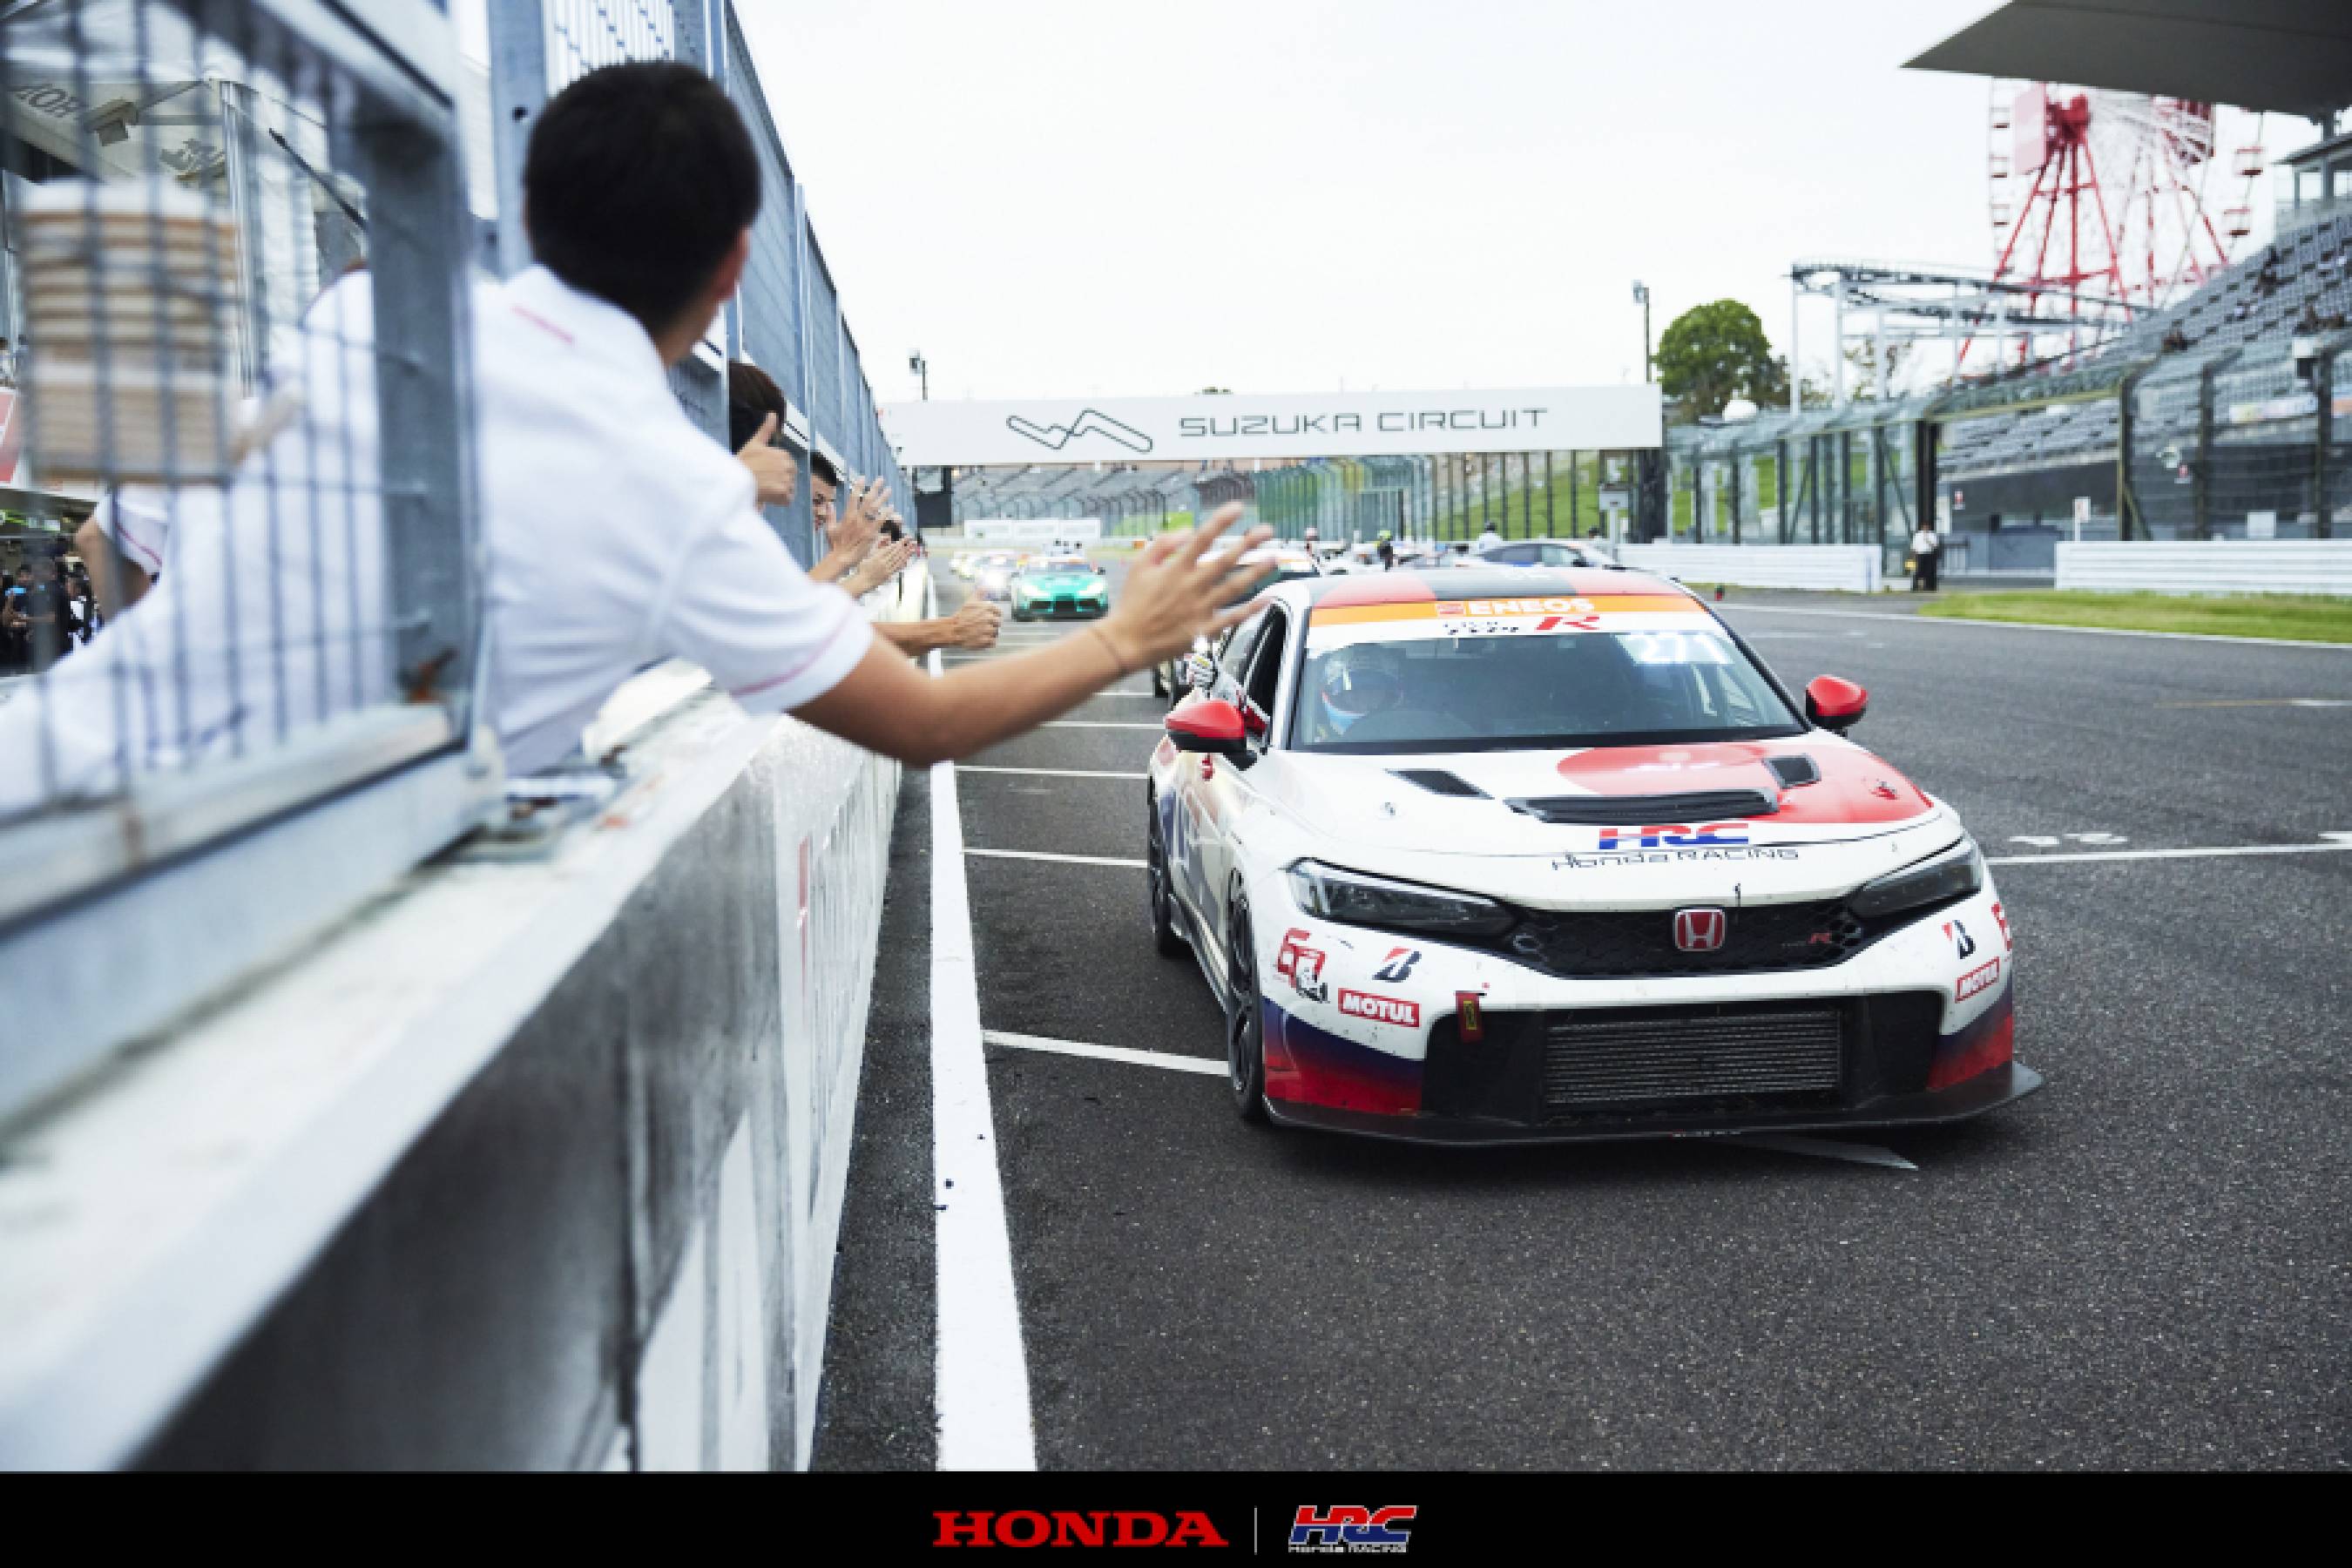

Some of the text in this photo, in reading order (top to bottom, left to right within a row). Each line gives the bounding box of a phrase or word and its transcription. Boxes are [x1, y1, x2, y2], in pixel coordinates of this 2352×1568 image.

[1179, 408, 1548, 437] SUZUKA CIRCUIT
[1468, 598, 1595, 615] ENEOS
[1598, 823, 1748, 849] HRC
[1678, 848, 1799, 861] RACING
[1344, 994, 1415, 1023] MOTUL
